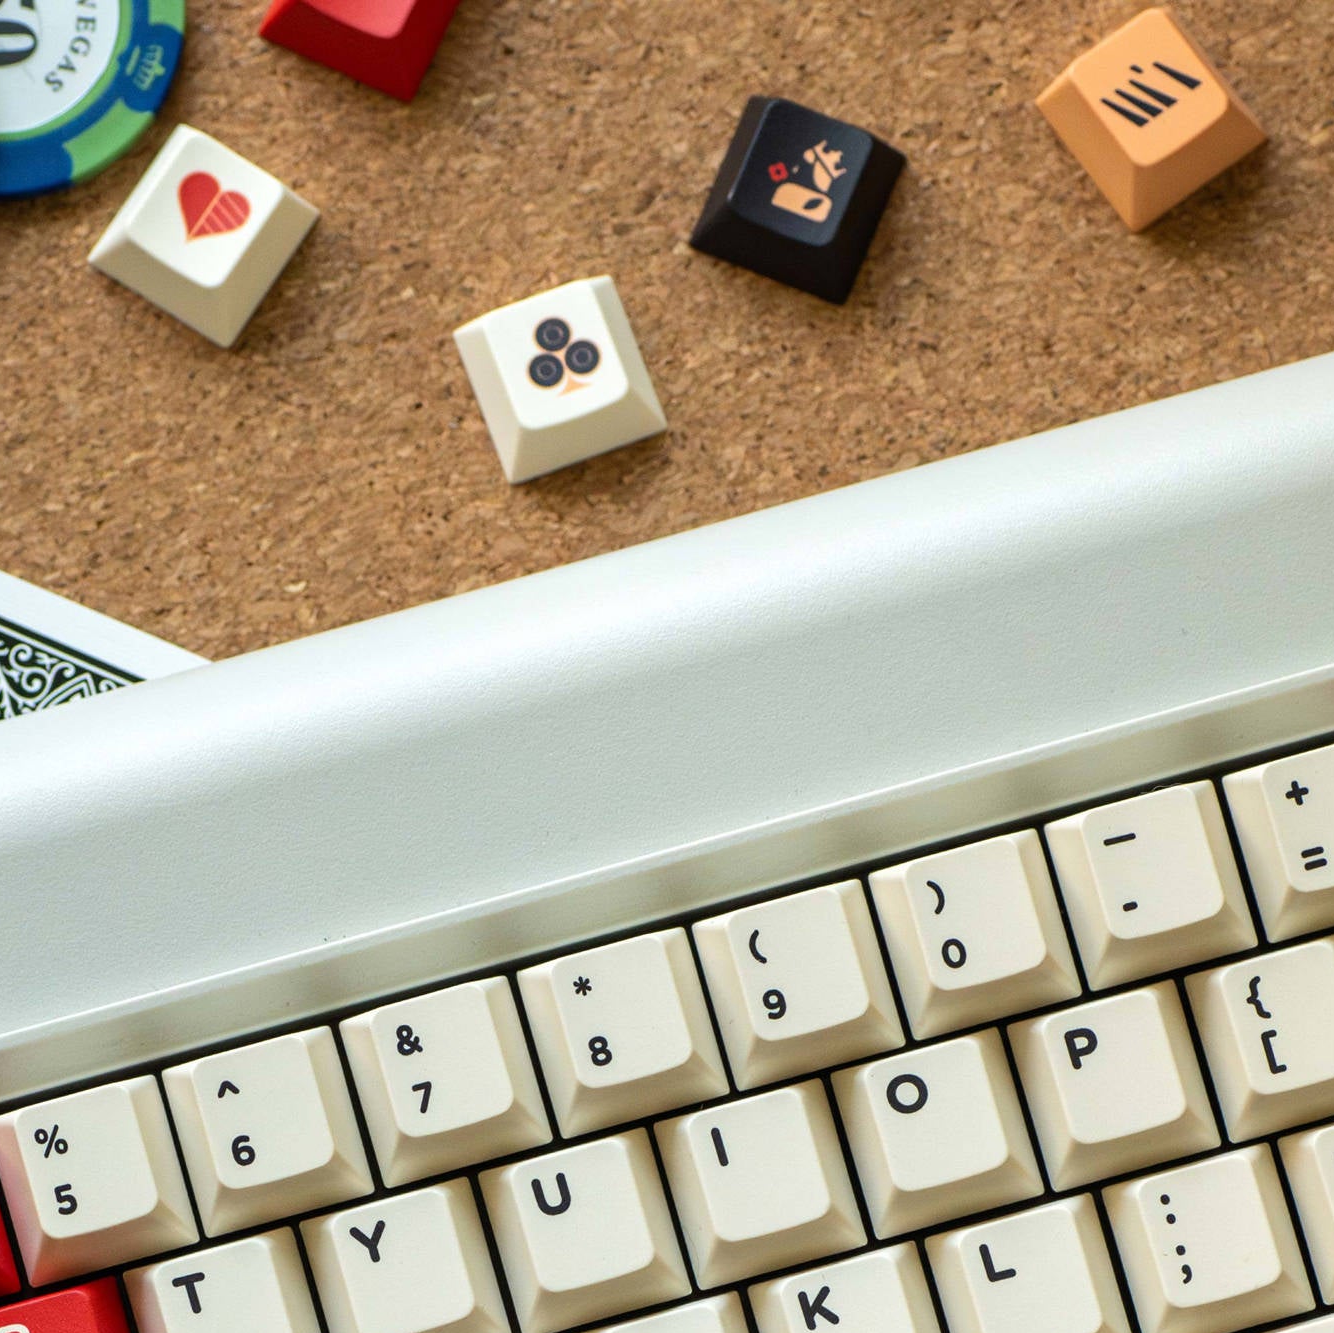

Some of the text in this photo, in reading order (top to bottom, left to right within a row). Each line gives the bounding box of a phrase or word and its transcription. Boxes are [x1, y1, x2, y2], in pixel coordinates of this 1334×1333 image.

[45, 0, 97, 93] EGAS
[762, 988, 787, 1020] 9
[395, 1024, 423, 1056] &
[588, 1035, 613, 1067] 8
[1064, 1027, 1098, 1070] P
[411, 1081, 432, 1114] 7
[886, 1073, 929, 1114] O
[34, 1124, 69, 1159] %
[231, 1135, 256, 1167] 6
[710, 1126, 729, 1167] I
[53, 1183, 78, 1216] 5
[530, 1172, 572, 1216] U
[349, 1220, 386, 1263] Y
[979, 1244, 1017, 1283] L
[172, 1271, 206, 1314] T
[797, 1285, 840, 1331] K
